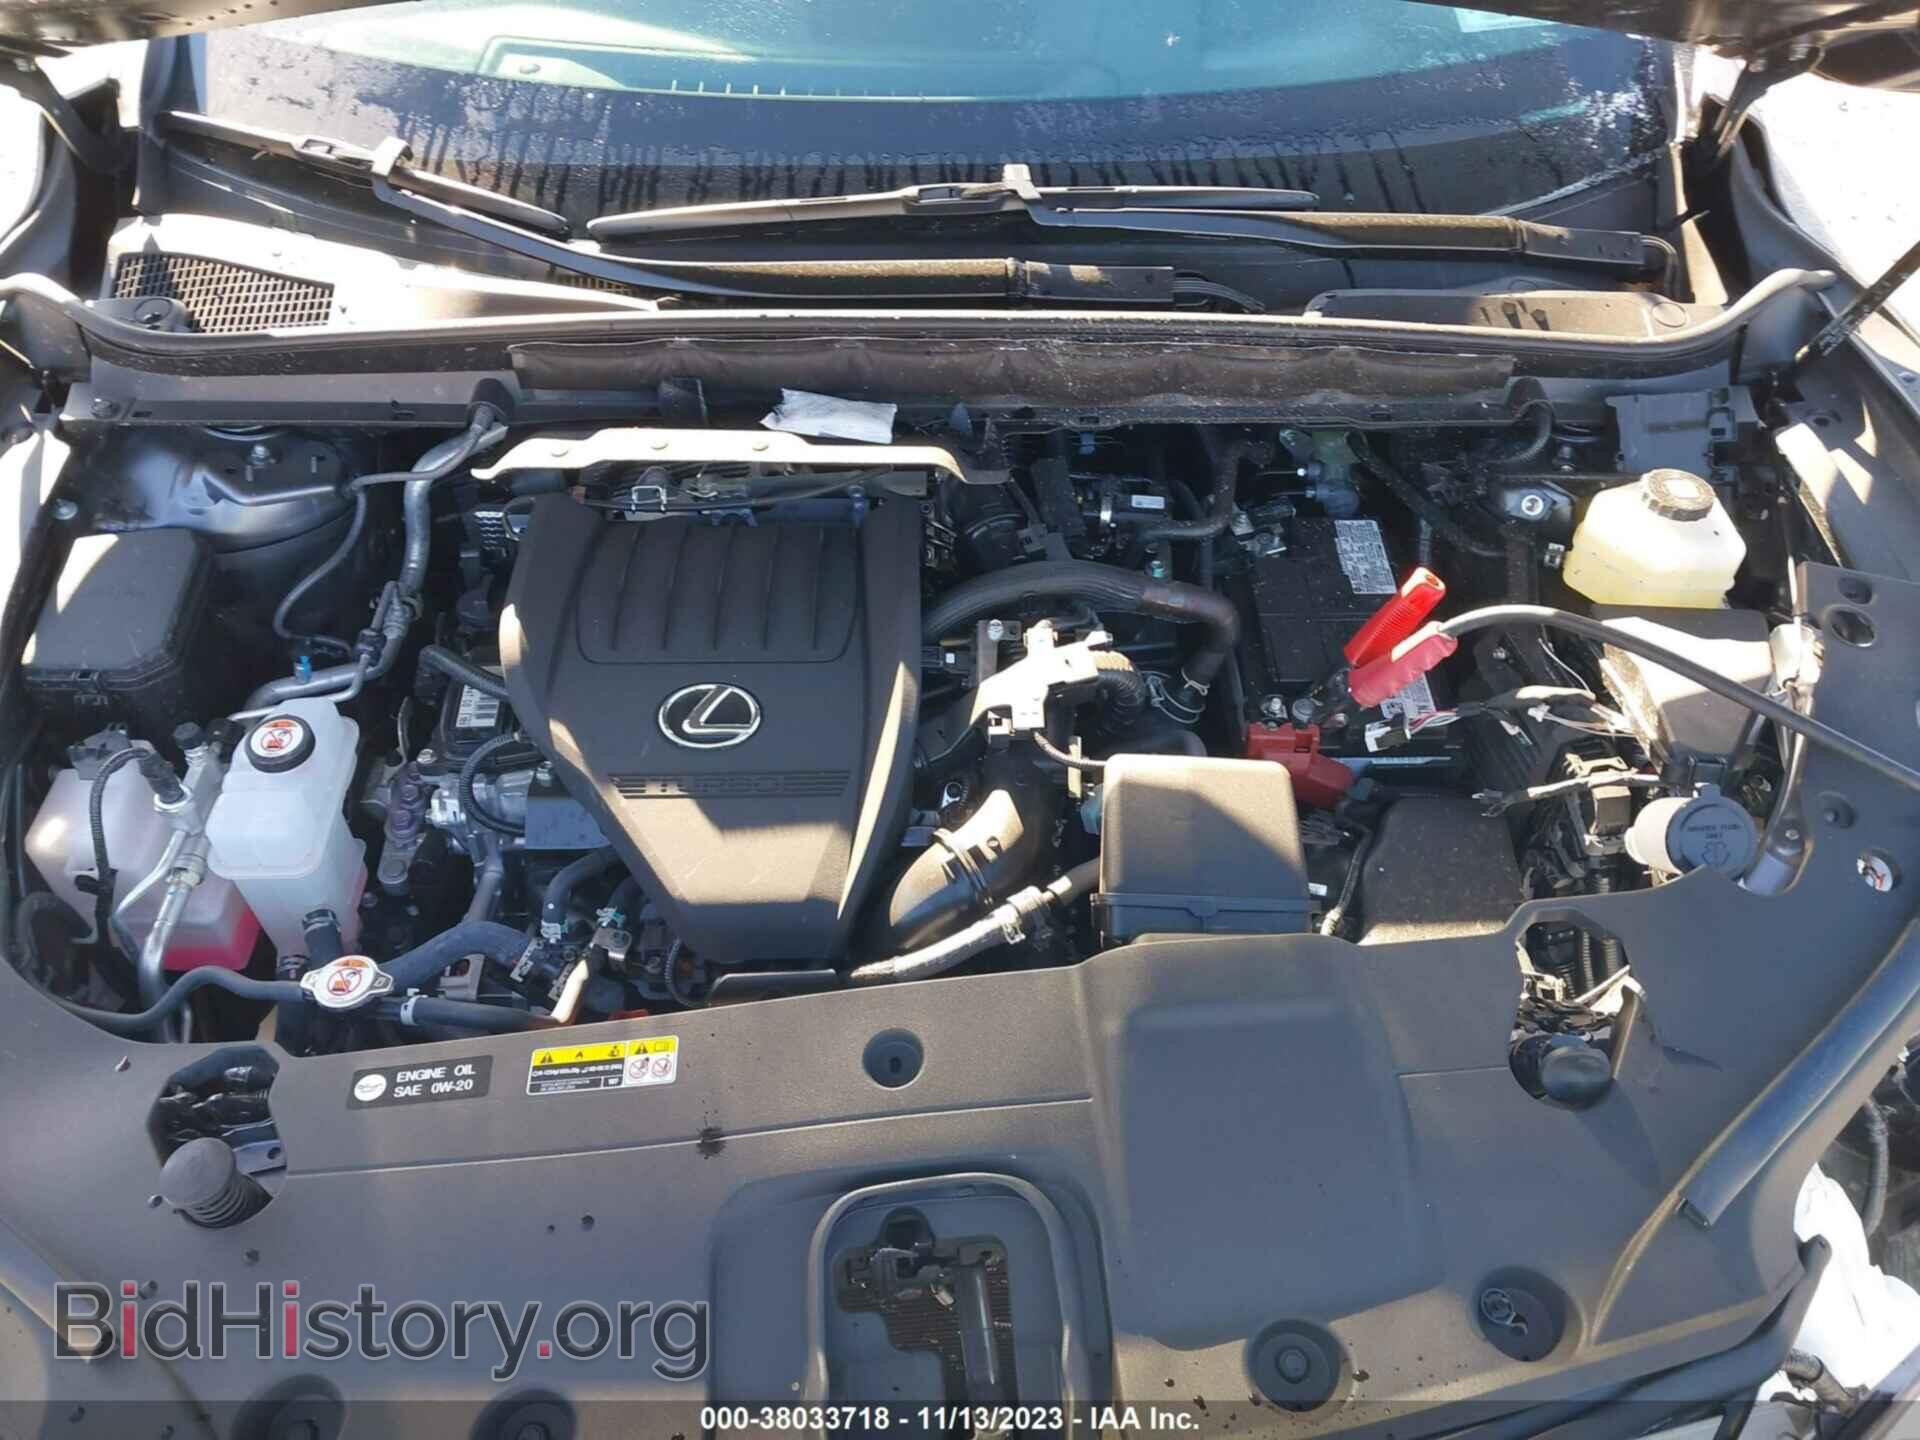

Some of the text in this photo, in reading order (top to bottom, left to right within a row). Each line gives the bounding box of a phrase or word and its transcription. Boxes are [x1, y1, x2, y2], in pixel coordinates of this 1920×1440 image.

[396, 1063, 476, 1083] ENGINE OIL
[393, 1079, 474, 1098] SAE 0W-20
